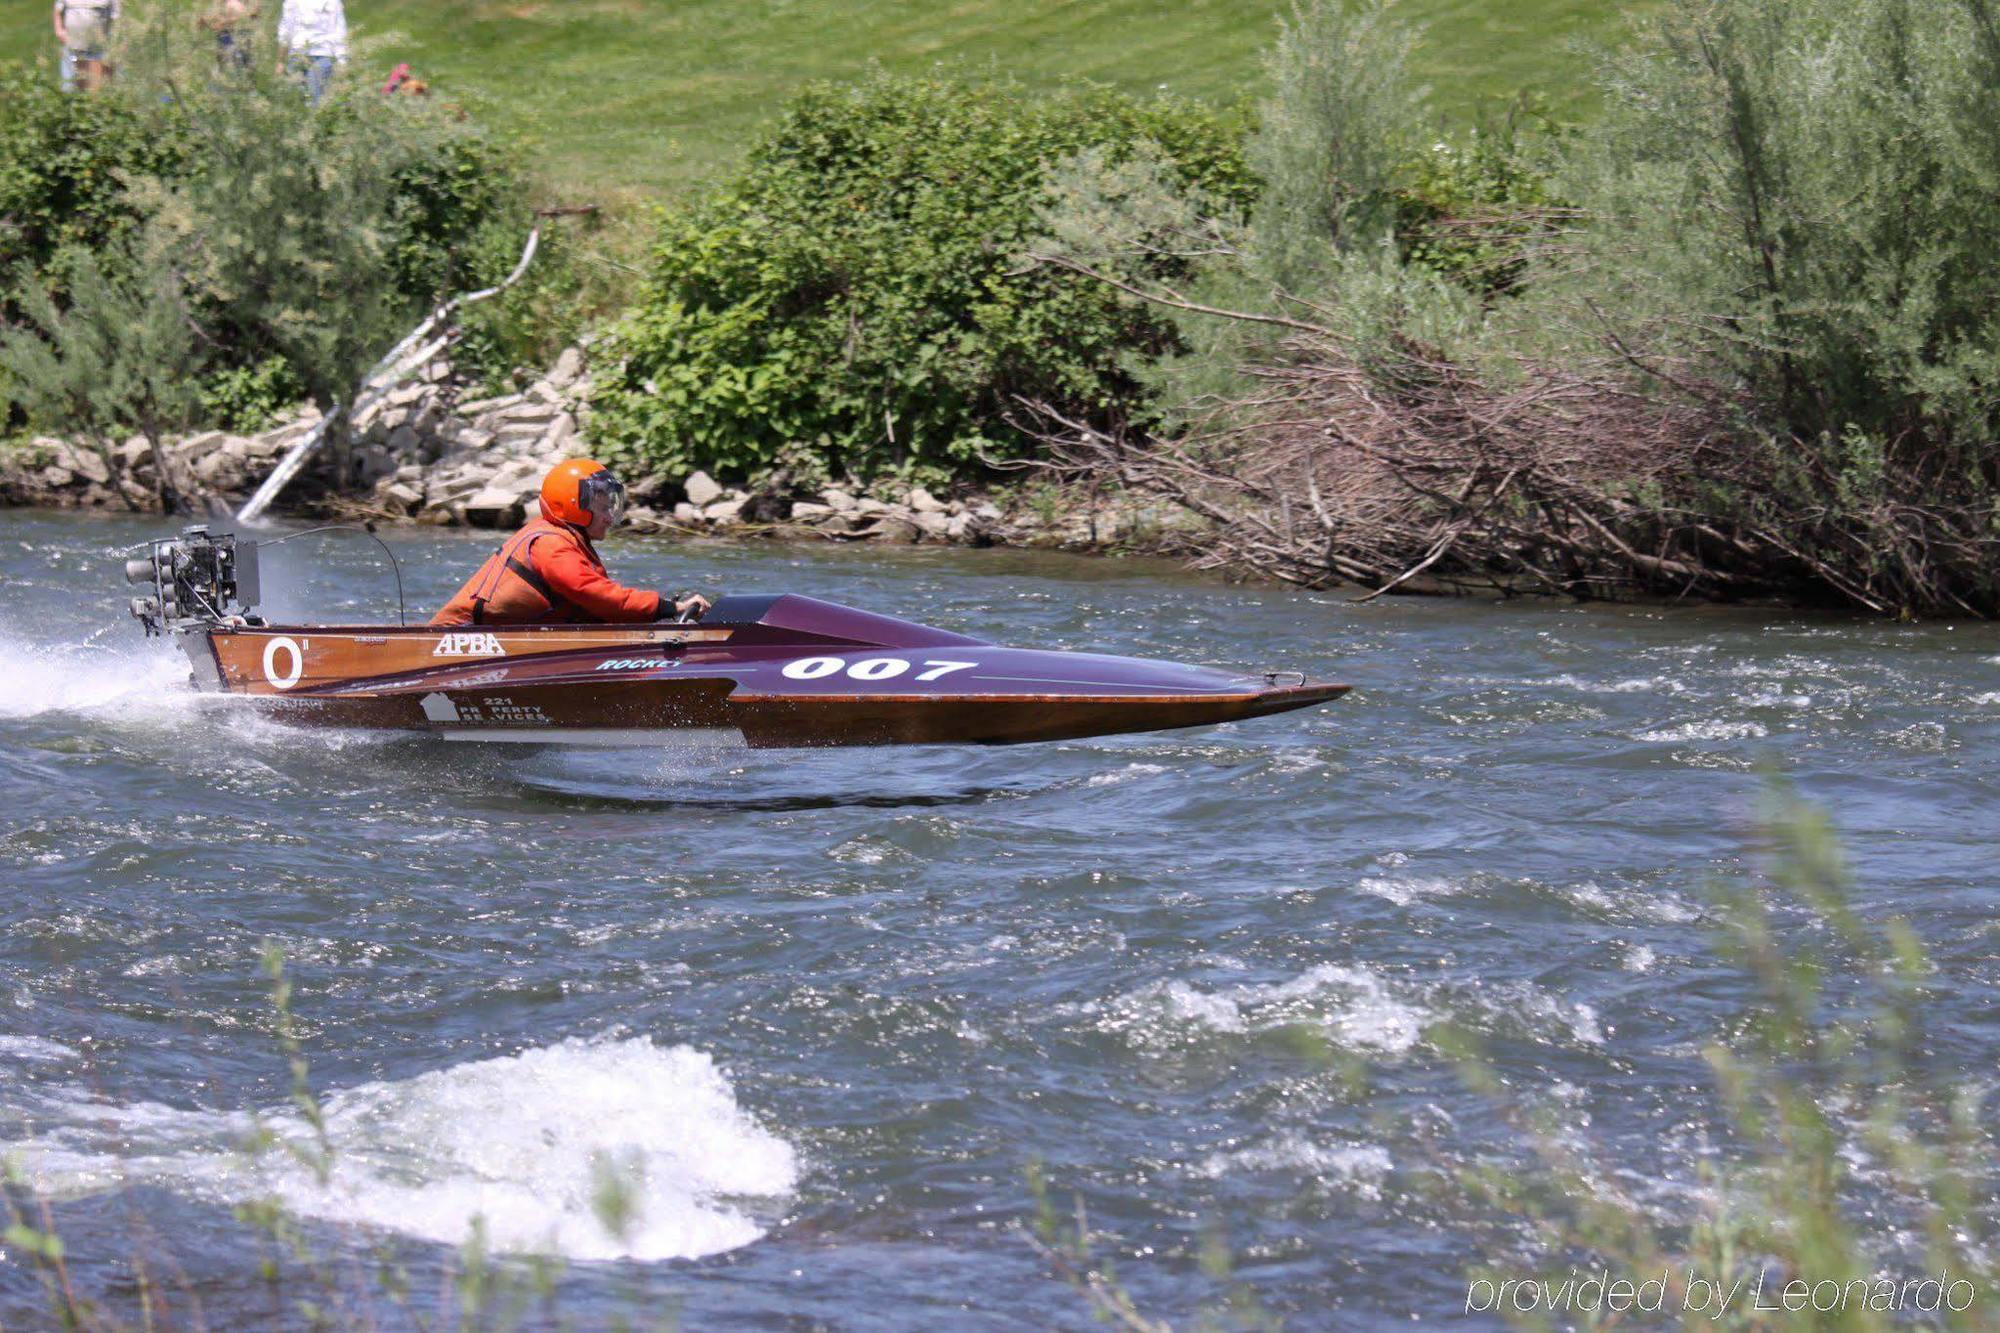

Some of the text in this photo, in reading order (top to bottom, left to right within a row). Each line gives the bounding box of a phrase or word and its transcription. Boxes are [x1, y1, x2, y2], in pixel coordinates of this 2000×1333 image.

[433, 633, 506, 656] APBA
[782, 657, 979, 681] 007
[483, 697, 513, 706] 221
[460, 706, 542, 714] PRPERTY
[462, 713, 546, 721] SEVICES
